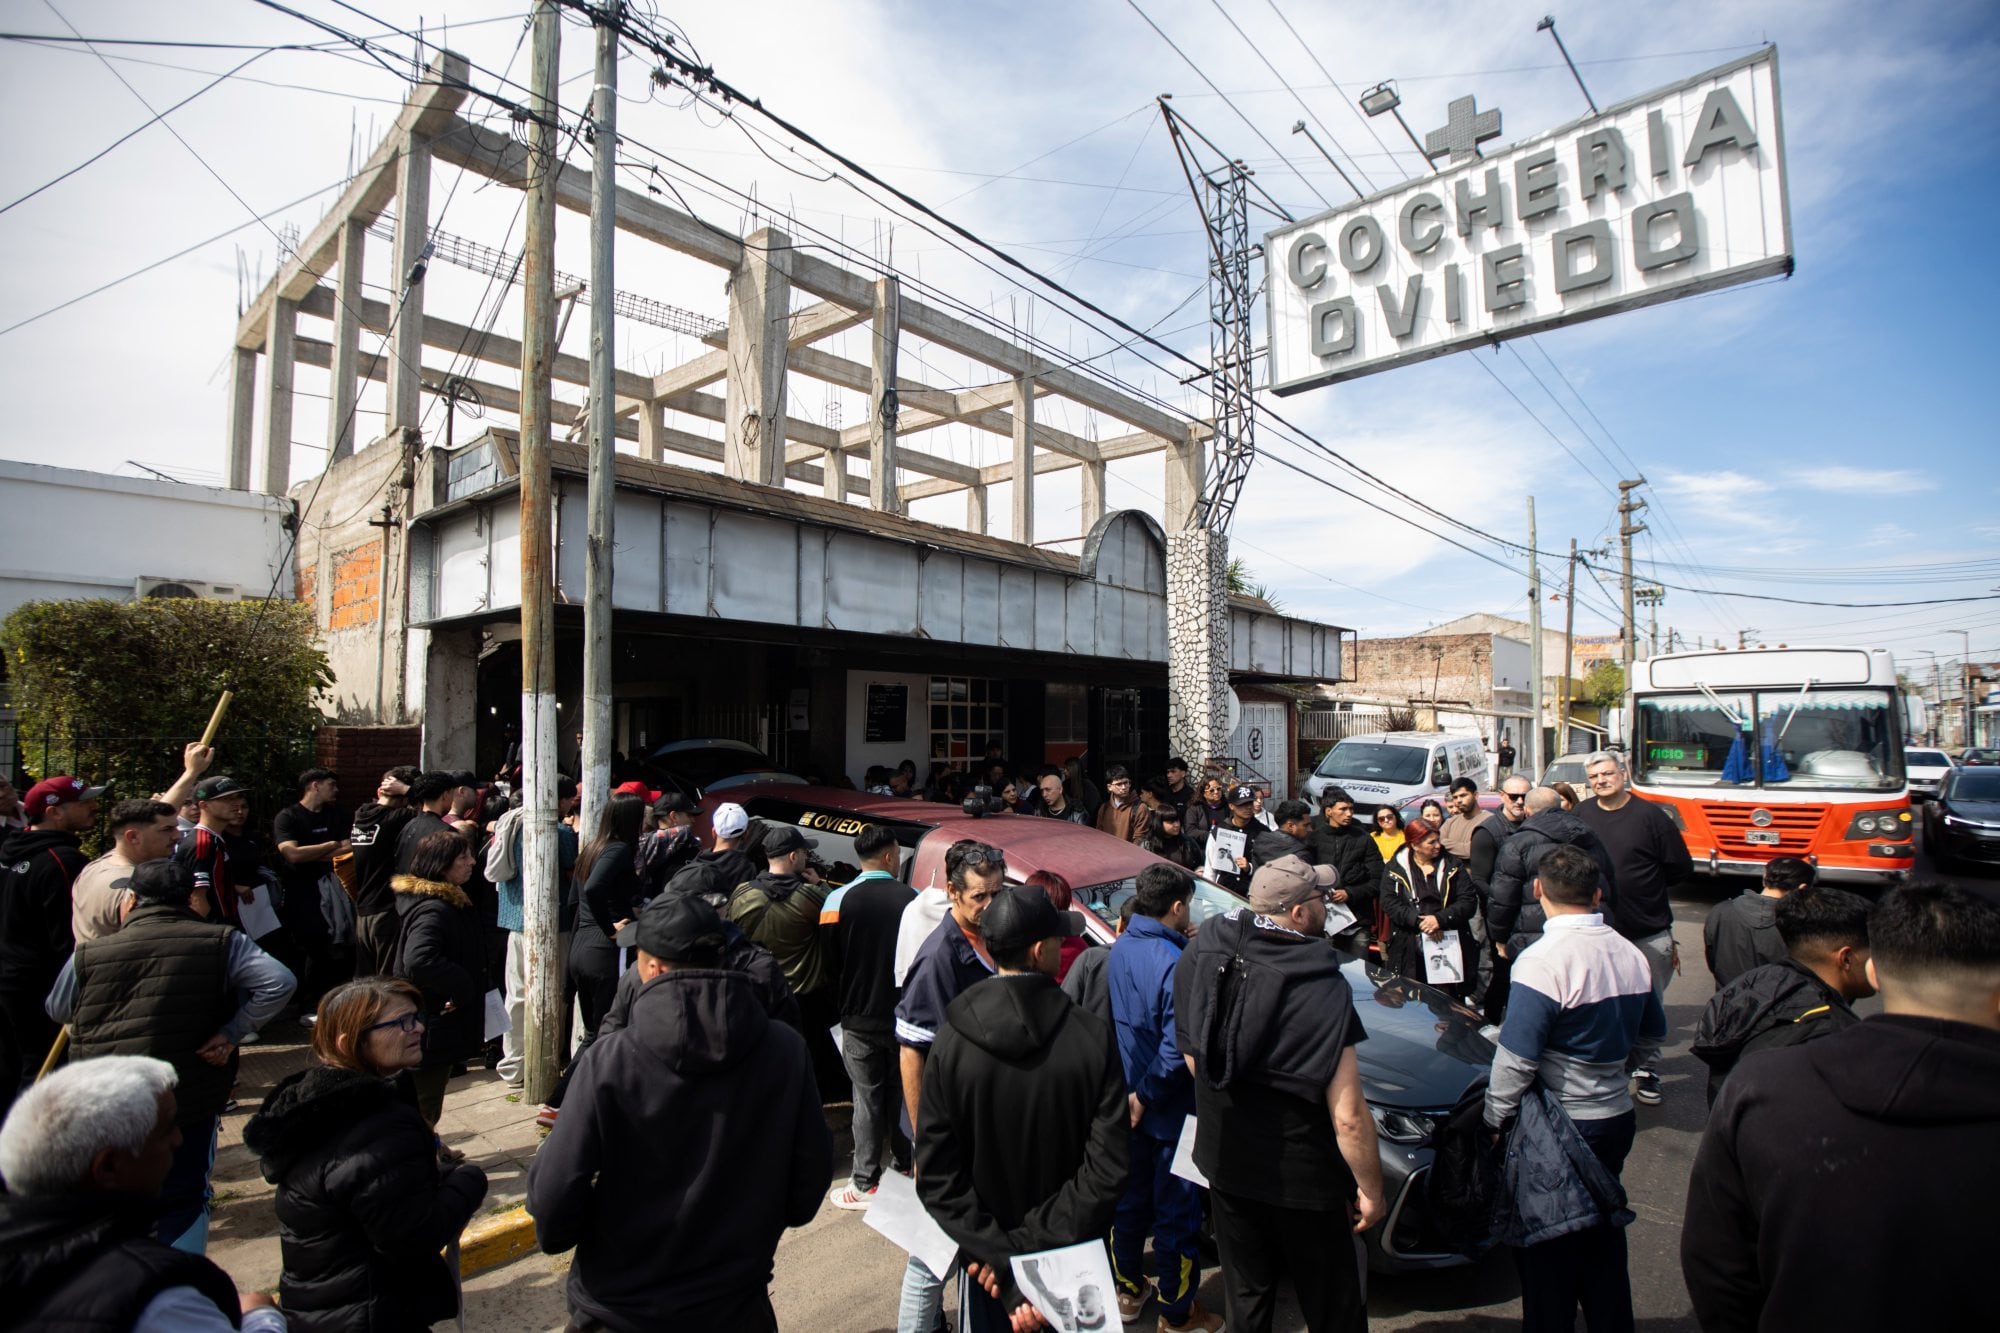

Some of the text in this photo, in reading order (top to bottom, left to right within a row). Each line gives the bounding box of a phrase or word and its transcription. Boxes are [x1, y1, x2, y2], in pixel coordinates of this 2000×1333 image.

[1287, 86, 1759, 289] COCHERIA
[1311, 191, 1699, 358] OVIEDO
[1343, 785, 1390, 795] OVIEDO
